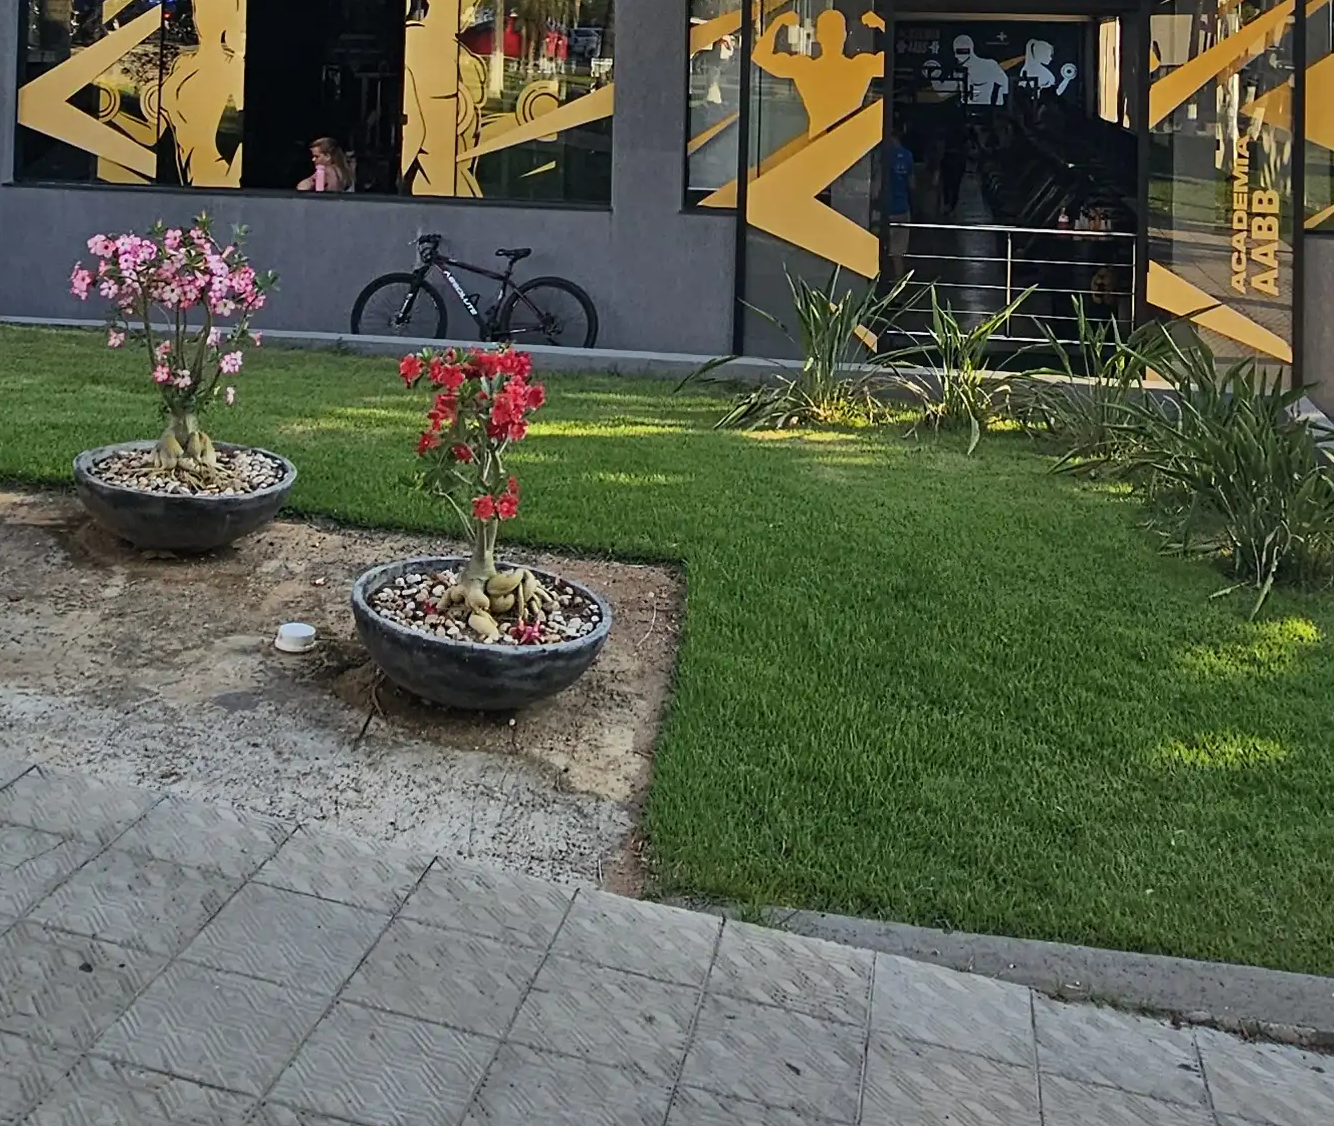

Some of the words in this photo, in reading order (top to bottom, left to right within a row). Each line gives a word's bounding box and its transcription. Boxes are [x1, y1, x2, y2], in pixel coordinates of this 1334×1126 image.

[1231, 135, 1250, 295] ACADEMIA
[1251, 189, 1280, 297] AABB
[443, 270, 478, 316] ABSOLUTE
